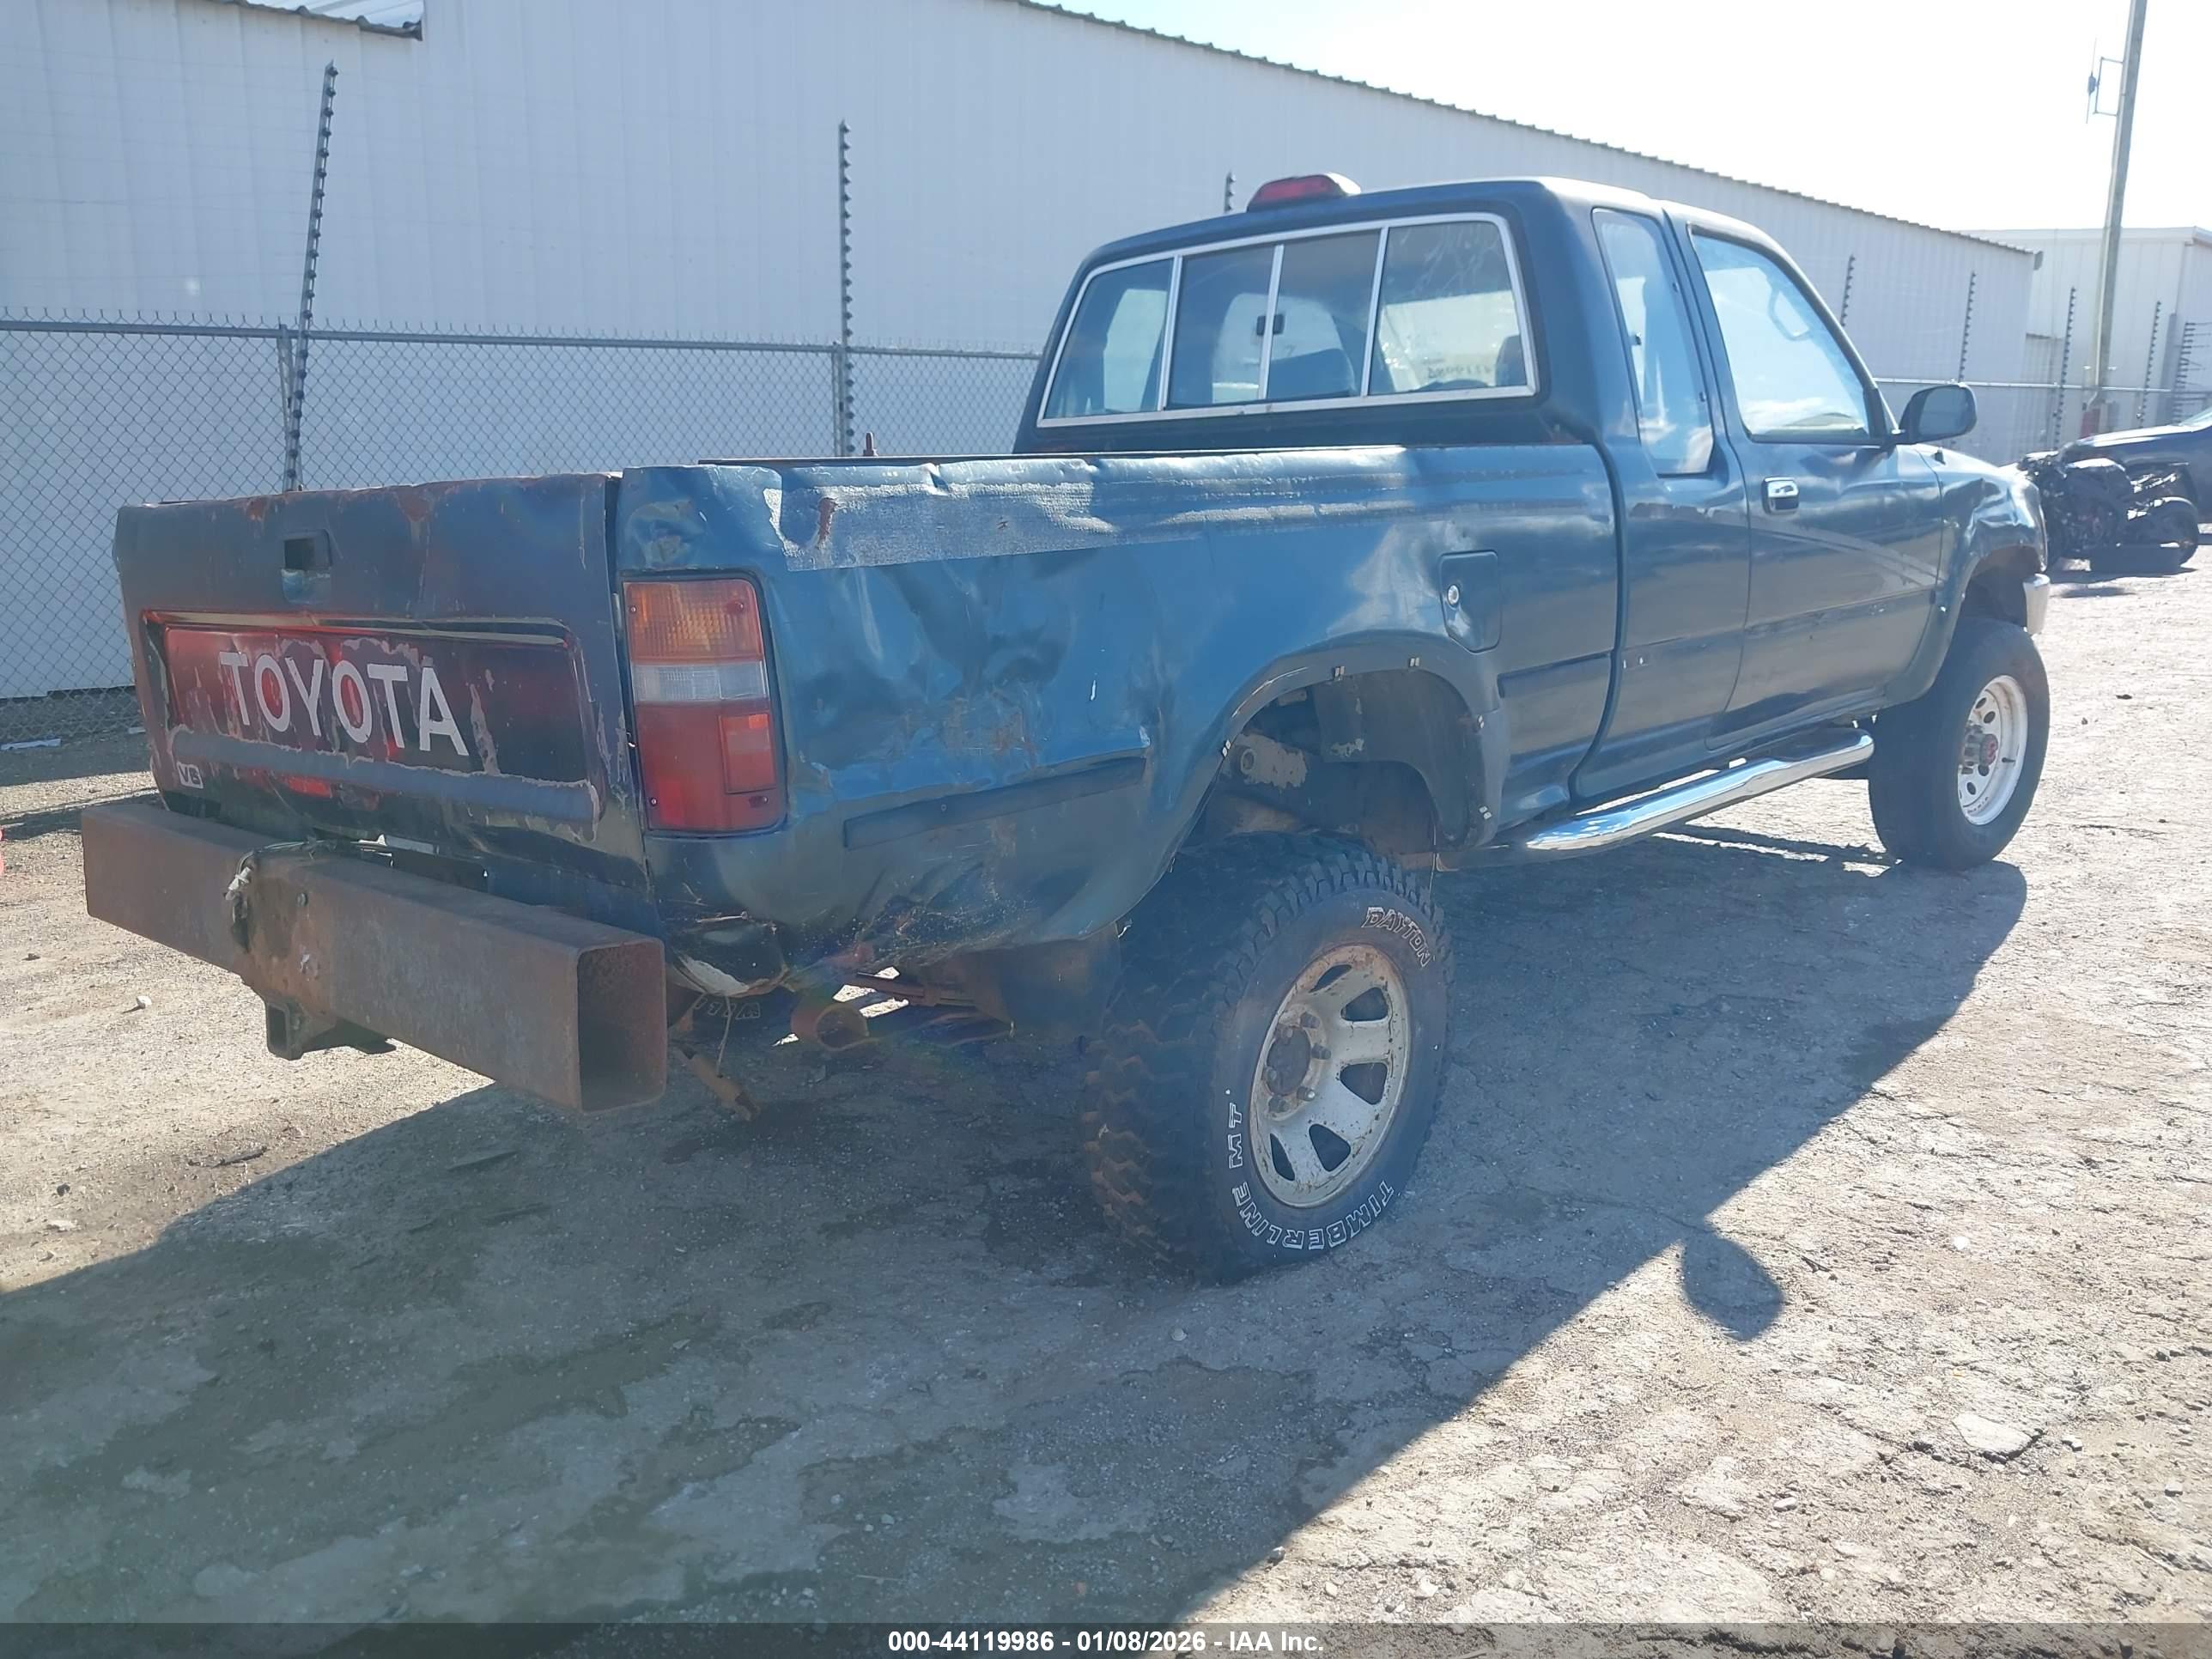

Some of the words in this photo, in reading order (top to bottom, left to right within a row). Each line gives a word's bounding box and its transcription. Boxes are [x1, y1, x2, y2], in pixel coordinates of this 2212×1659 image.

[219, 651, 469, 756] TOYOTA
[1361, 906, 1431, 968] DAYTON
[1232, 1180, 1395, 1250] TIMBERLINE
